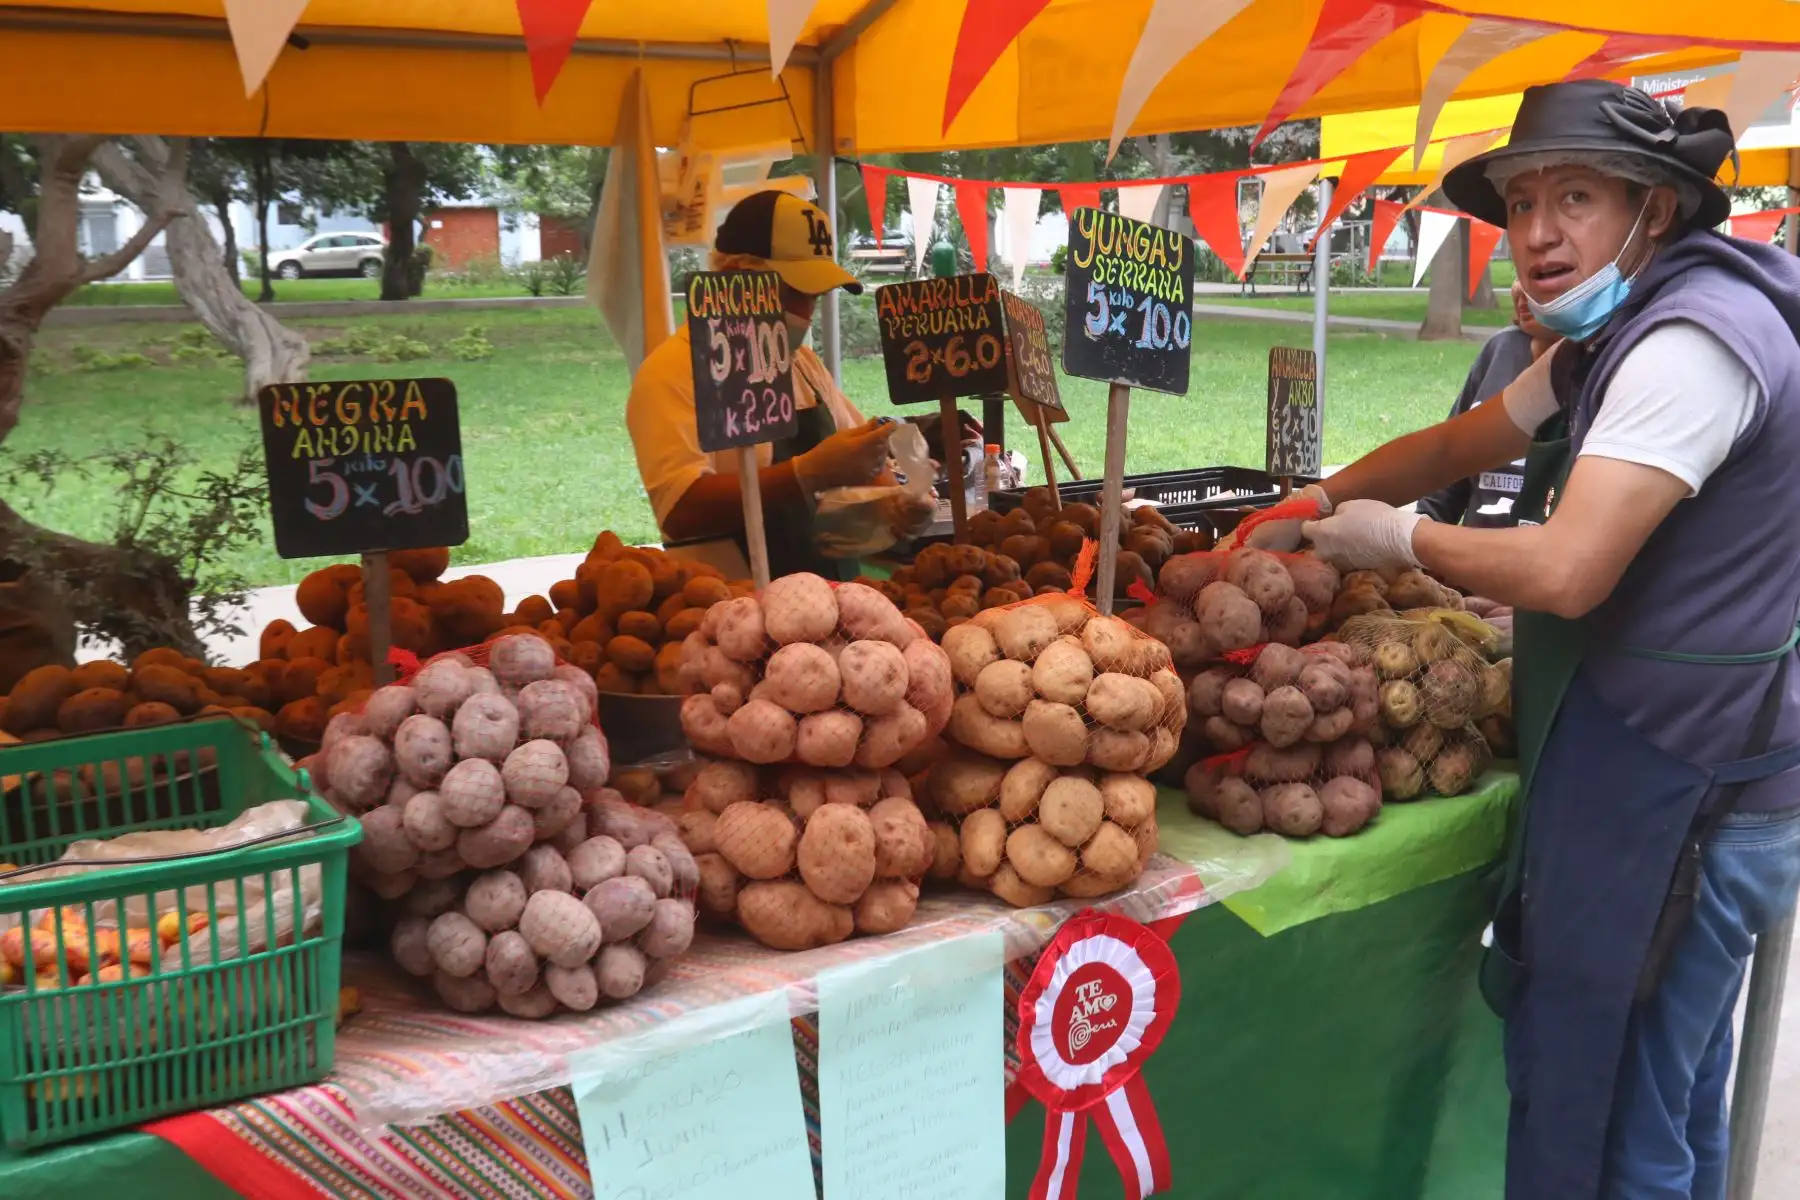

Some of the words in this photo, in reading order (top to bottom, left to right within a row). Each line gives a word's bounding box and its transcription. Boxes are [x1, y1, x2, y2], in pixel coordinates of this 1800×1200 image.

[801, 209, 833, 256] LA
[1073, 207, 1184, 272] YUNGAY
[689, 274, 783, 318] CANCHAN
[879, 275, 1001, 318] AMARILLA
[1093, 254, 1185, 304] SERRANA
[884, 304, 992, 340] PERUANA
[1084, 280, 1110, 336] 5
[708, 317, 732, 382] 5
[1272, 347, 1316, 381] AMARILLA
[270, 379, 428, 428] NEGRA
[291, 423, 418, 460] ANDINA
[304, 457, 351, 521] 5
[1075, 978, 1103, 1004] TE
